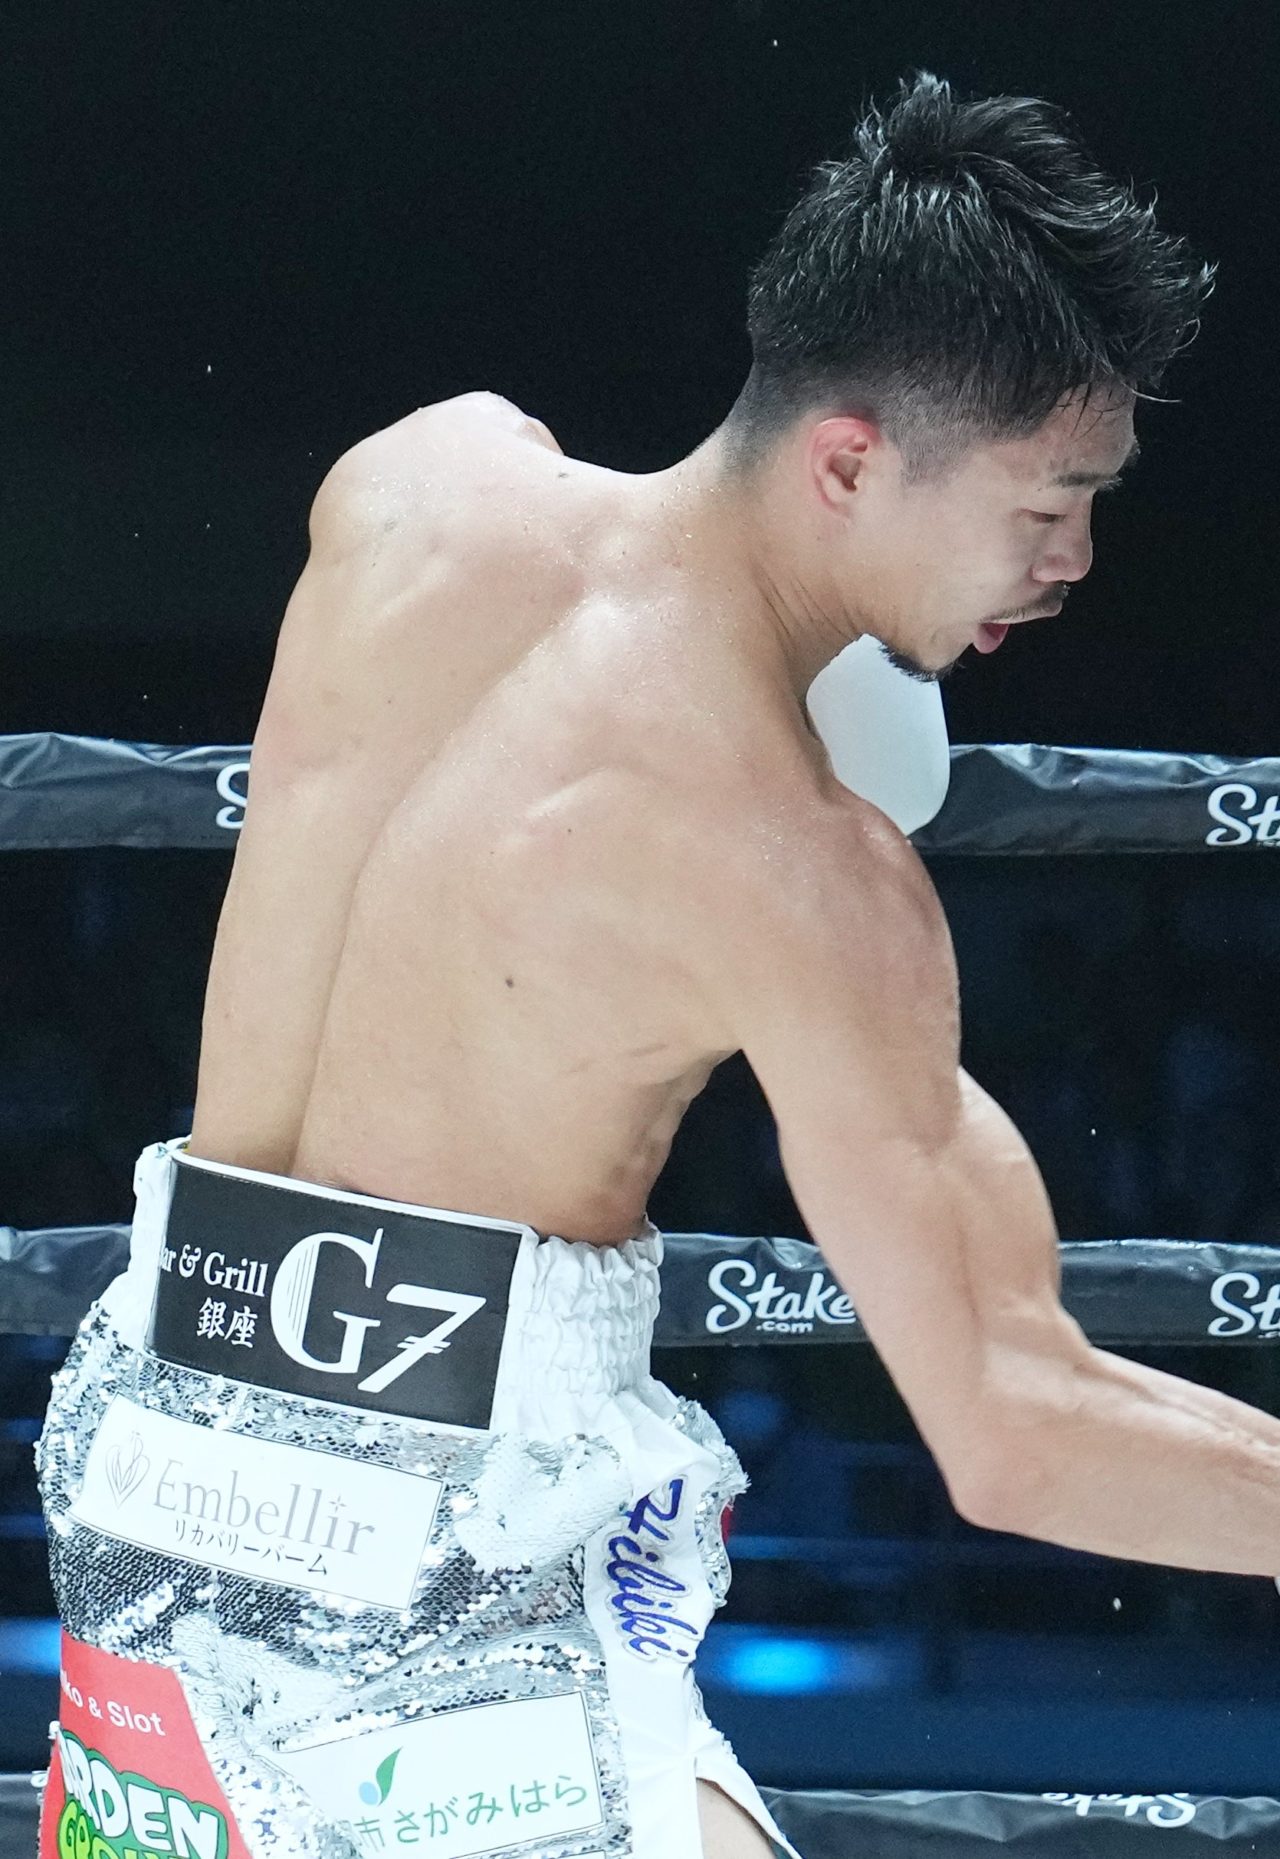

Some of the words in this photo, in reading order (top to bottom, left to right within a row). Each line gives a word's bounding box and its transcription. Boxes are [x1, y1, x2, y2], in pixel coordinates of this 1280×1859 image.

[179, 1244, 202, 1278] &
[203, 1252, 269, 1297] Grill
[706, 1259, 856, 1333] Stake
[196, 1296, 259, 1348] 銀座
[270, 1228, 487, 1393] G7
[756, 1320, 814, 1333] .com
[153, 1458, 376, 1556] Embellir
[174, 1518, 328, 1576] リカバリーバーム
[87, 1697, 104, 1720] &
[107, 1701, 167, 1737] Slot
